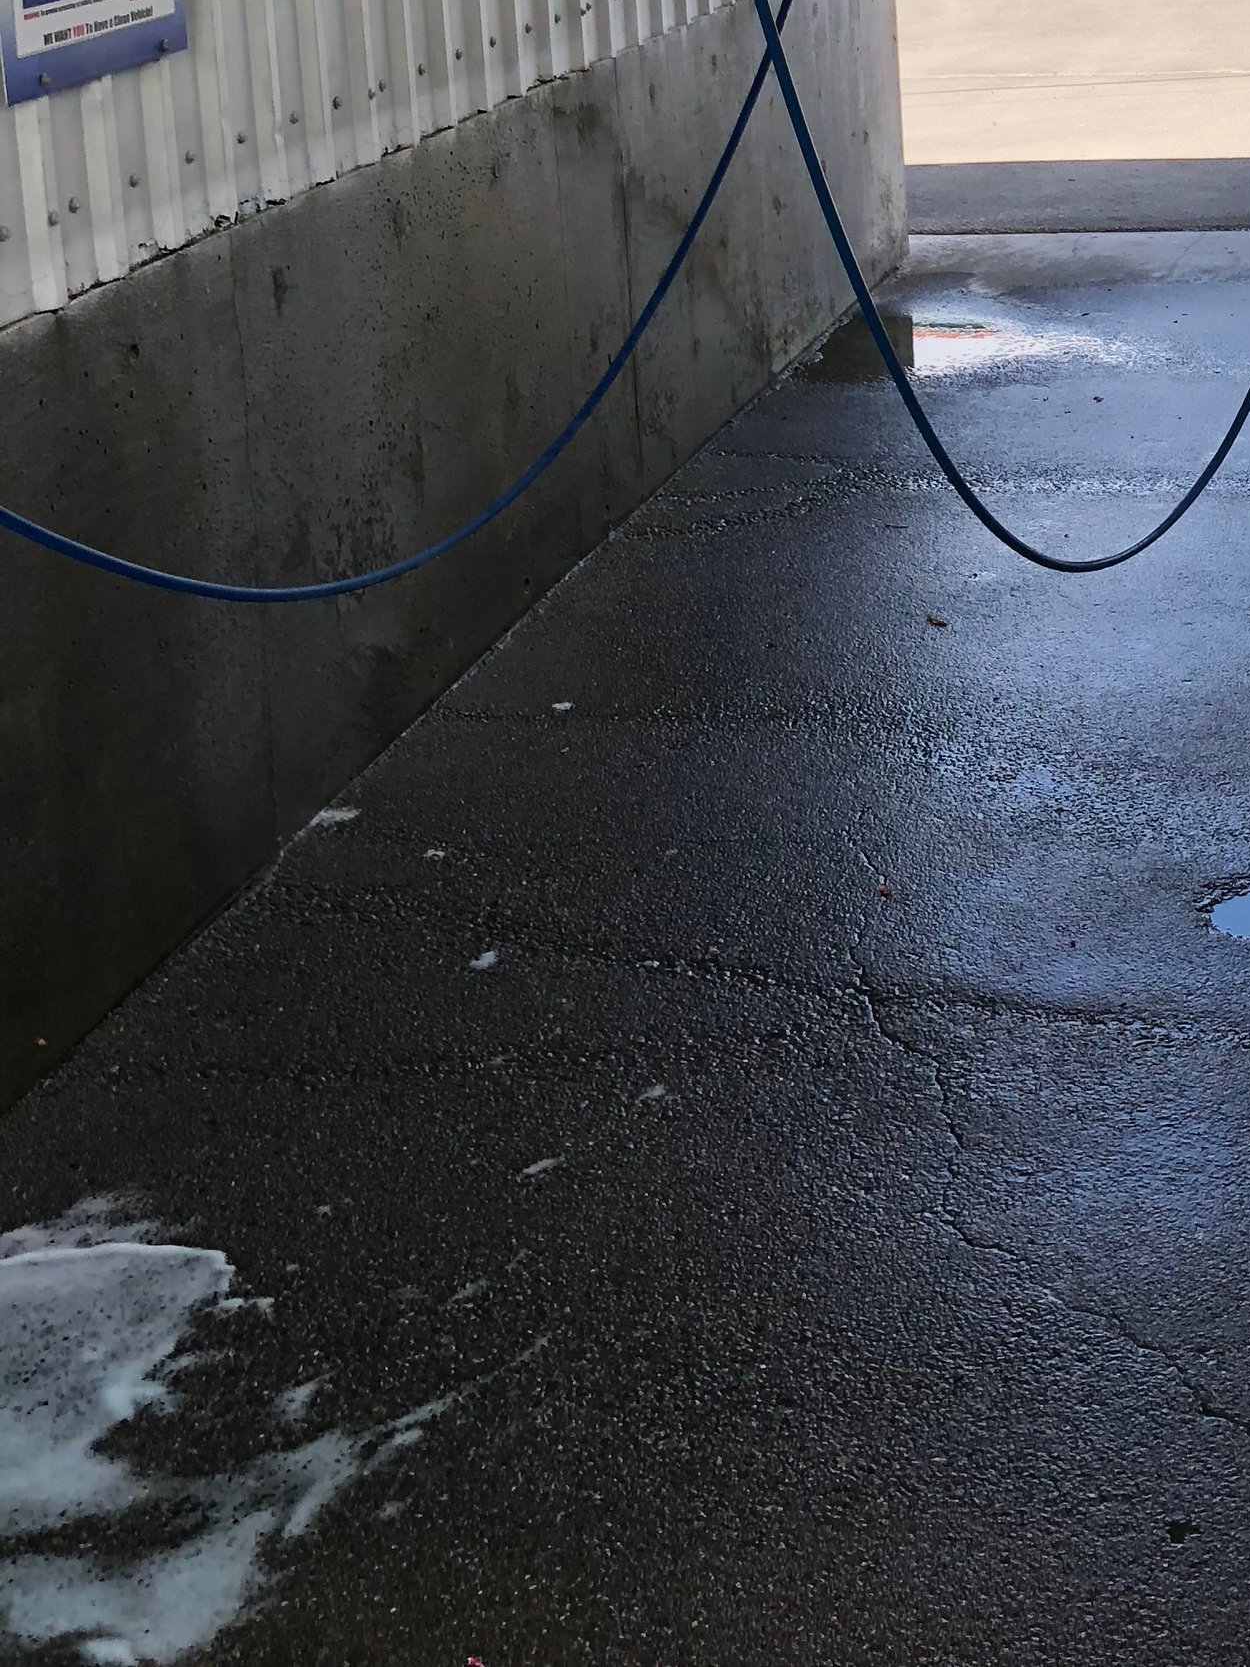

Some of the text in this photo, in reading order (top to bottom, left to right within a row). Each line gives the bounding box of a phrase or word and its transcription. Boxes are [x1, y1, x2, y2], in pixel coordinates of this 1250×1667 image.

[43, 33, 53, 46] WE
[54, 28, 72, 43] WANT
[72, 24, 85, 38] YOU
[85, 22, 93, 34] To
[94, 20, 108, 32] Have
[113, 13, 130, 27] Clean
